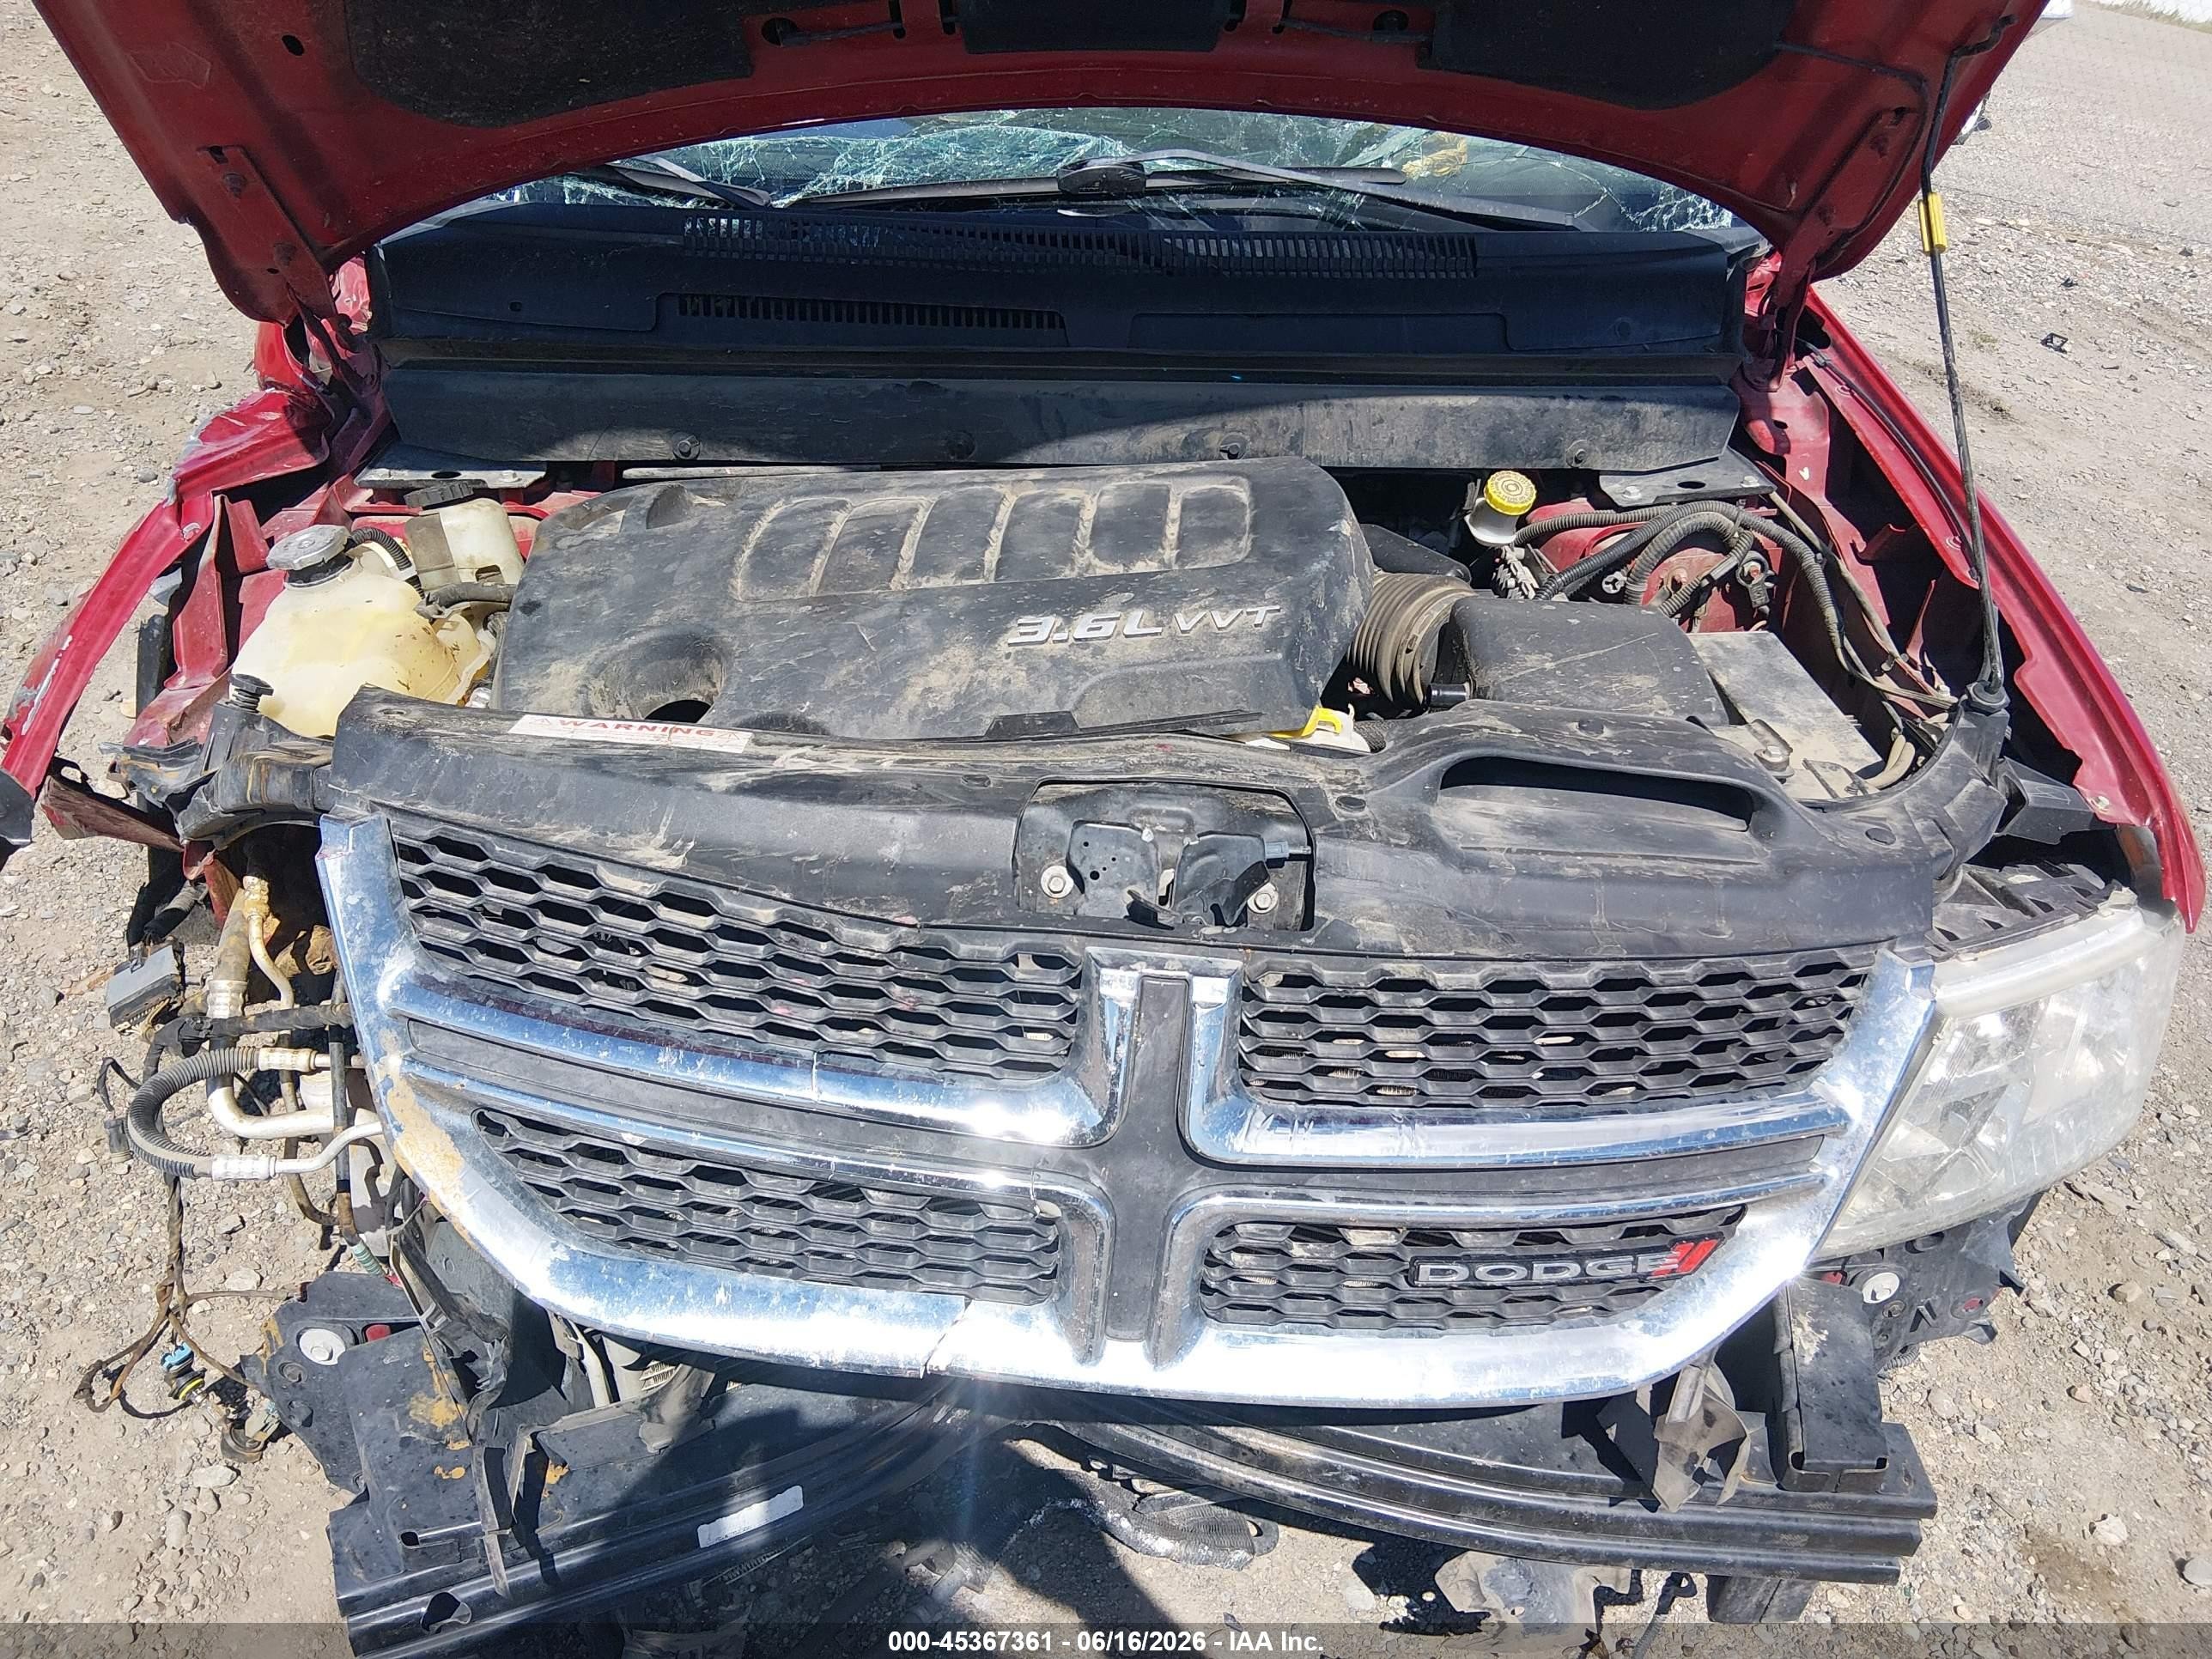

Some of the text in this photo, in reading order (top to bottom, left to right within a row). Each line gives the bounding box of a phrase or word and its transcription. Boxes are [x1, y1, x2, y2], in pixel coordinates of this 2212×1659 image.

[1007, 605, 1280, 645] 3.6L VVT
[559, 720, 715, 737] WARNING
[1418, 1253, 1680, 1282] DODGE
